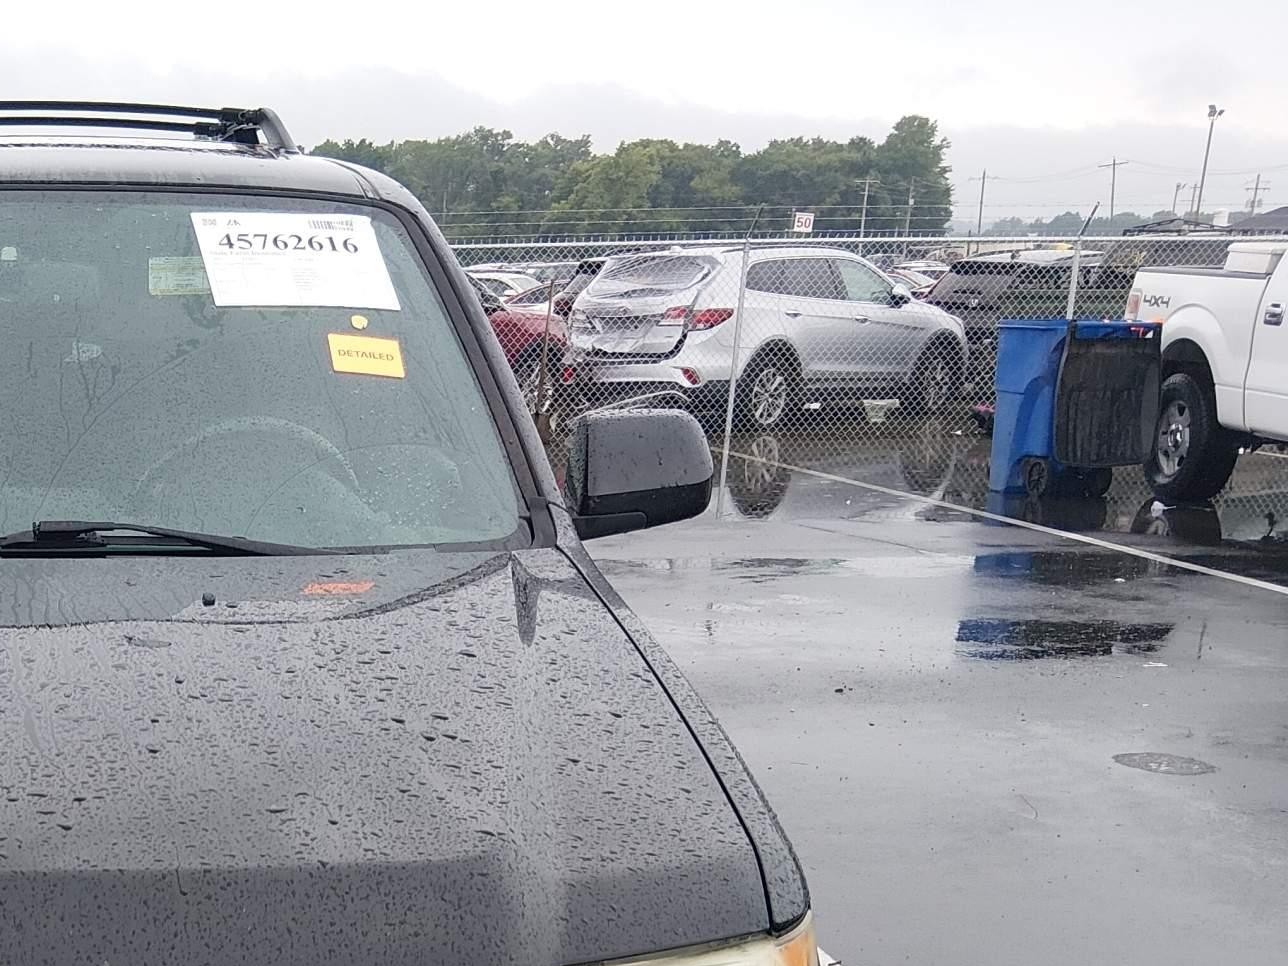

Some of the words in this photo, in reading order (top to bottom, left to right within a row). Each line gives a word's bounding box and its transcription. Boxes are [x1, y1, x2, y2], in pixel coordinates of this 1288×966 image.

[796, 216, 812, 229] 50
[216, 232, 360, 255] 45762616
[337, 348, 395, 362] DETAILED
